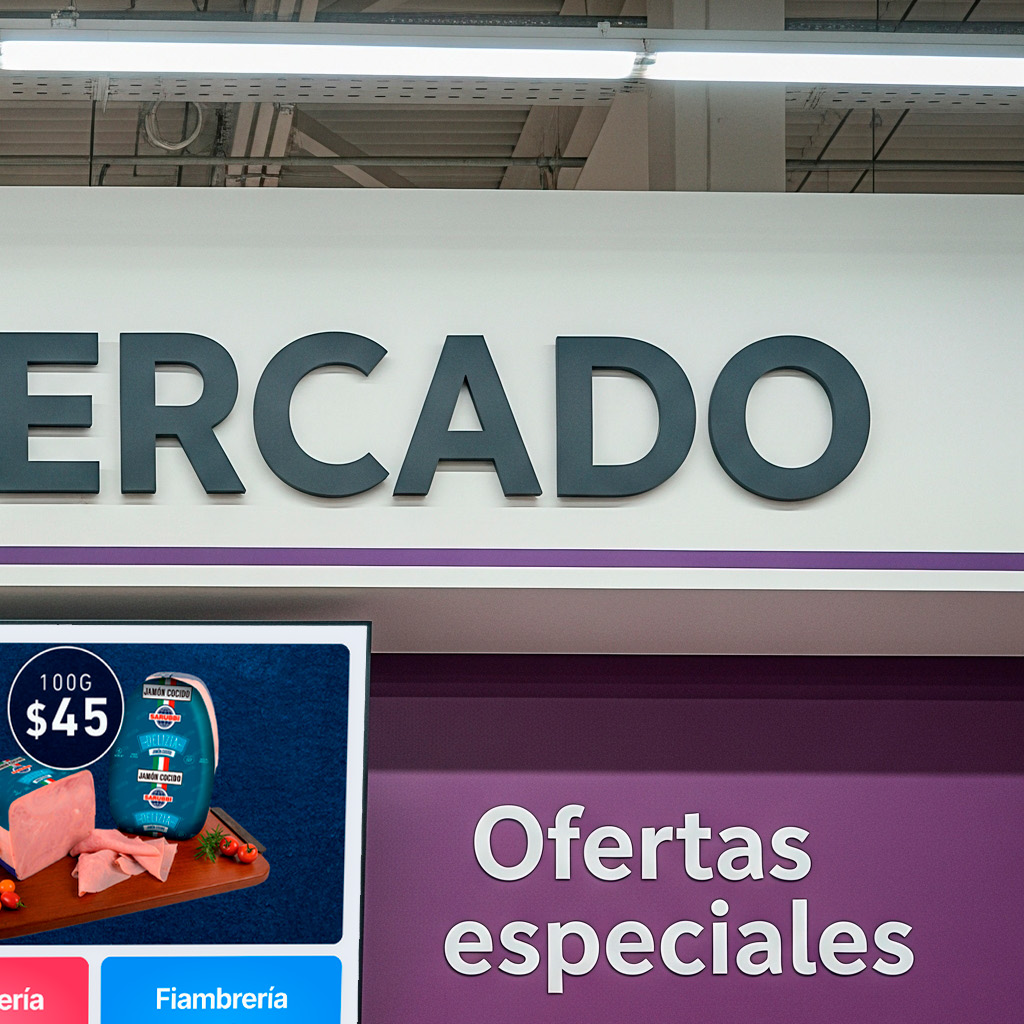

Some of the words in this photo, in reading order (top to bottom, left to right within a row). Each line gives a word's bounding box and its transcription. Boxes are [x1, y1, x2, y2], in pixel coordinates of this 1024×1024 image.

[40, 673, 92, 691] 100G
[166, 689, 190, 699] COCIDO
[26, 697, 108, 740] $45
[159, 773, 182, 783] COCIDO
[473, 804, 812, 882] Ofertas
[443, 898, 915, 995] especiales
[157, 985, 288, 1010] Fiambrería
